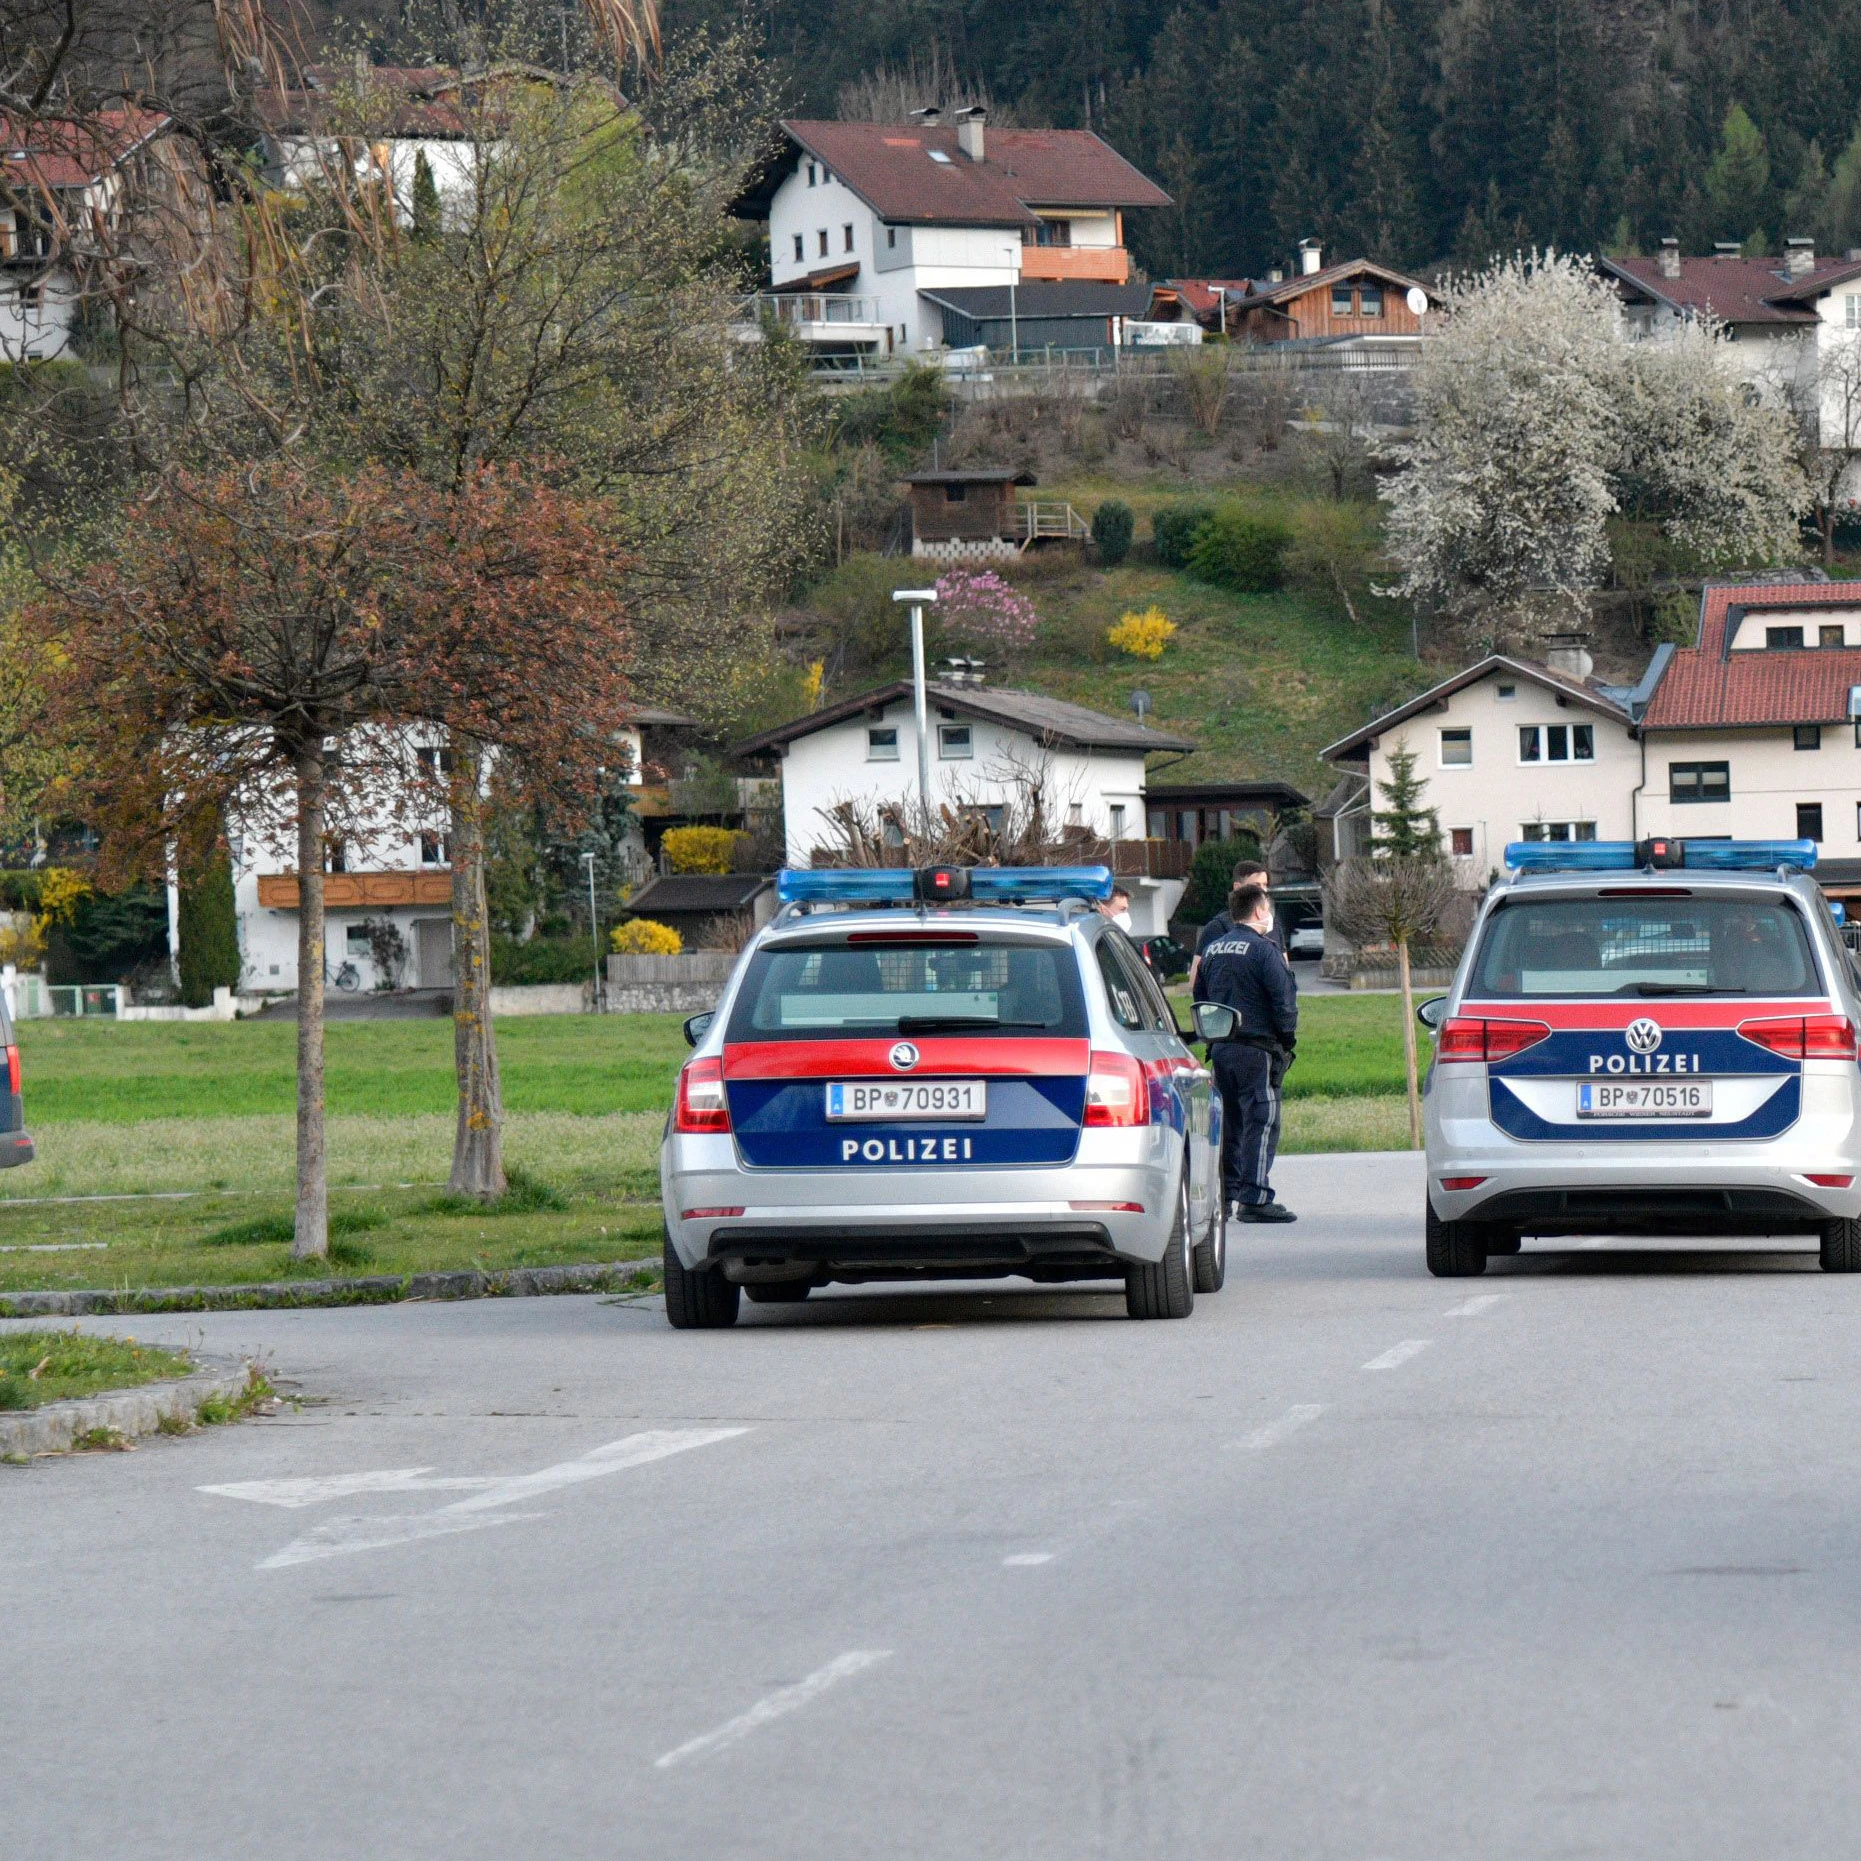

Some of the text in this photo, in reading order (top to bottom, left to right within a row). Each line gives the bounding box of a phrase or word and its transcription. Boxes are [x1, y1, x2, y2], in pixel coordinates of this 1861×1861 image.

[1205, 941, 1250, 957] POLIZEI
[1589, 1053, 1699, 1073] POLIZEI
[854, 1088, 882, 1111] BP
[901, 1087, 972, 1110] 70931
[1600, 1088, 1624, 1107] BP
[1641, 1087, 1700, 1106] 70516
[842, 1138, 972, 1161] POLIZEI
